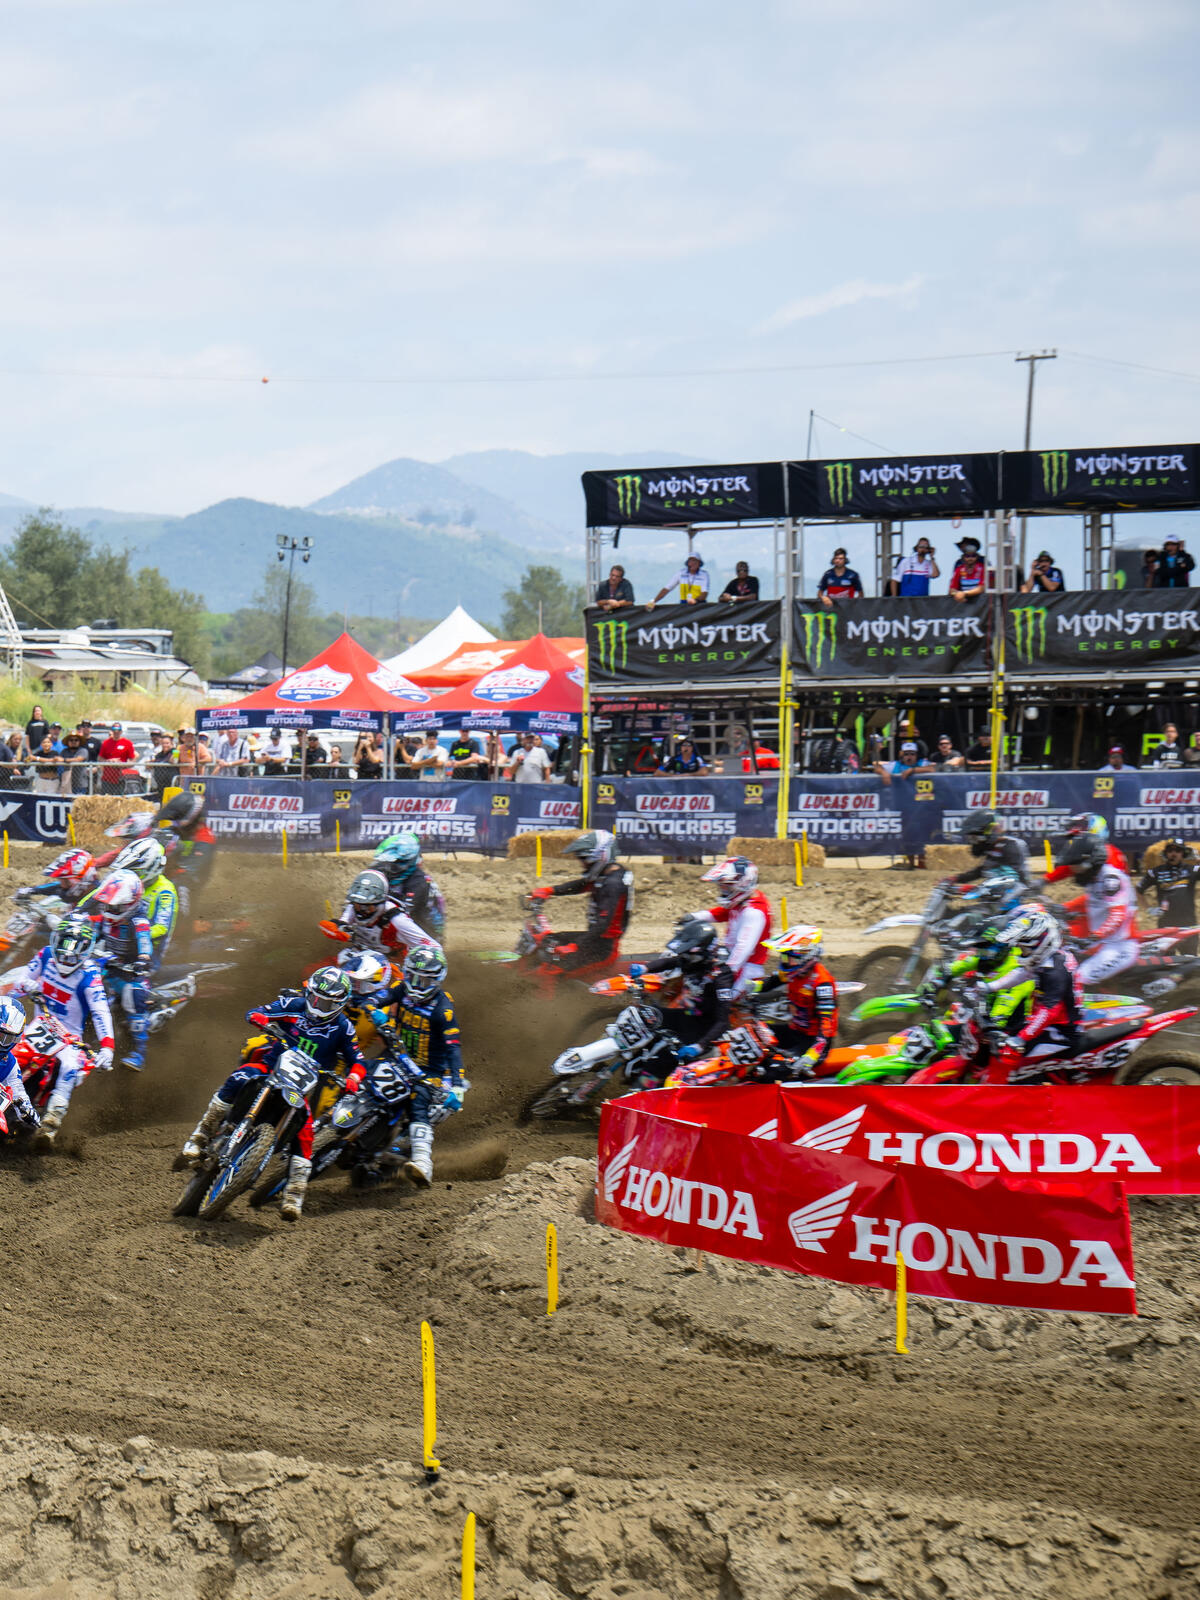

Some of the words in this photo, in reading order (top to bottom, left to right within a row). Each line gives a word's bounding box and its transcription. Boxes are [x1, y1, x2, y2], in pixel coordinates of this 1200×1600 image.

[1075, 453, 1187, 474] MONSTER
[859, 463, 966, 487] MONSTER
[1091, 476, 1170, 486] ENERGY
[648, 475, 751, 498] MONSTER
[875, 486, 949, 497] ENERGY
[664, 497, 736, 508] ENERGY
[847, 615, 984, 642] MONSTER
[1057, 609, 1200, 637] MONSTER
[638, 622, 772, 650] MONSTER
[867, 645, 962, 657] ENERGY
[1078, 639, 1179, 651] ENERGY
[658, 650, 751, 664] ENERGY
[232, 795, 275, 810] LUCAS
[279, 797, 300, 812] OIL
[640, 796, 687, 811] LUCAS
[689, 796, 711, 811] OIL
[802, 794, 850, 810] LUCAS
[852, 794, 876, 809] OIL
[1022, 790, 1045, 806] OIL
[1144, 789, 1195, 804] LUCAS
[386, 798, 429, 813] LUCAS
[432, 799, 453, 813] OIL
[207, 817, 321, 834] MOTOCROSS
[360, 820, 476, 836] MOTOCROSS
[616, 818, 736, 834] MOTOCROSS
[23, 1025, 57, 1053] 23
[375, 1067, 408, 1100] 28
[864, 1132, 1162, 1173] HONDA
[620, 1165, 764, 1241] HONDA
[849, 1215, 1136, 1289] HONDA
